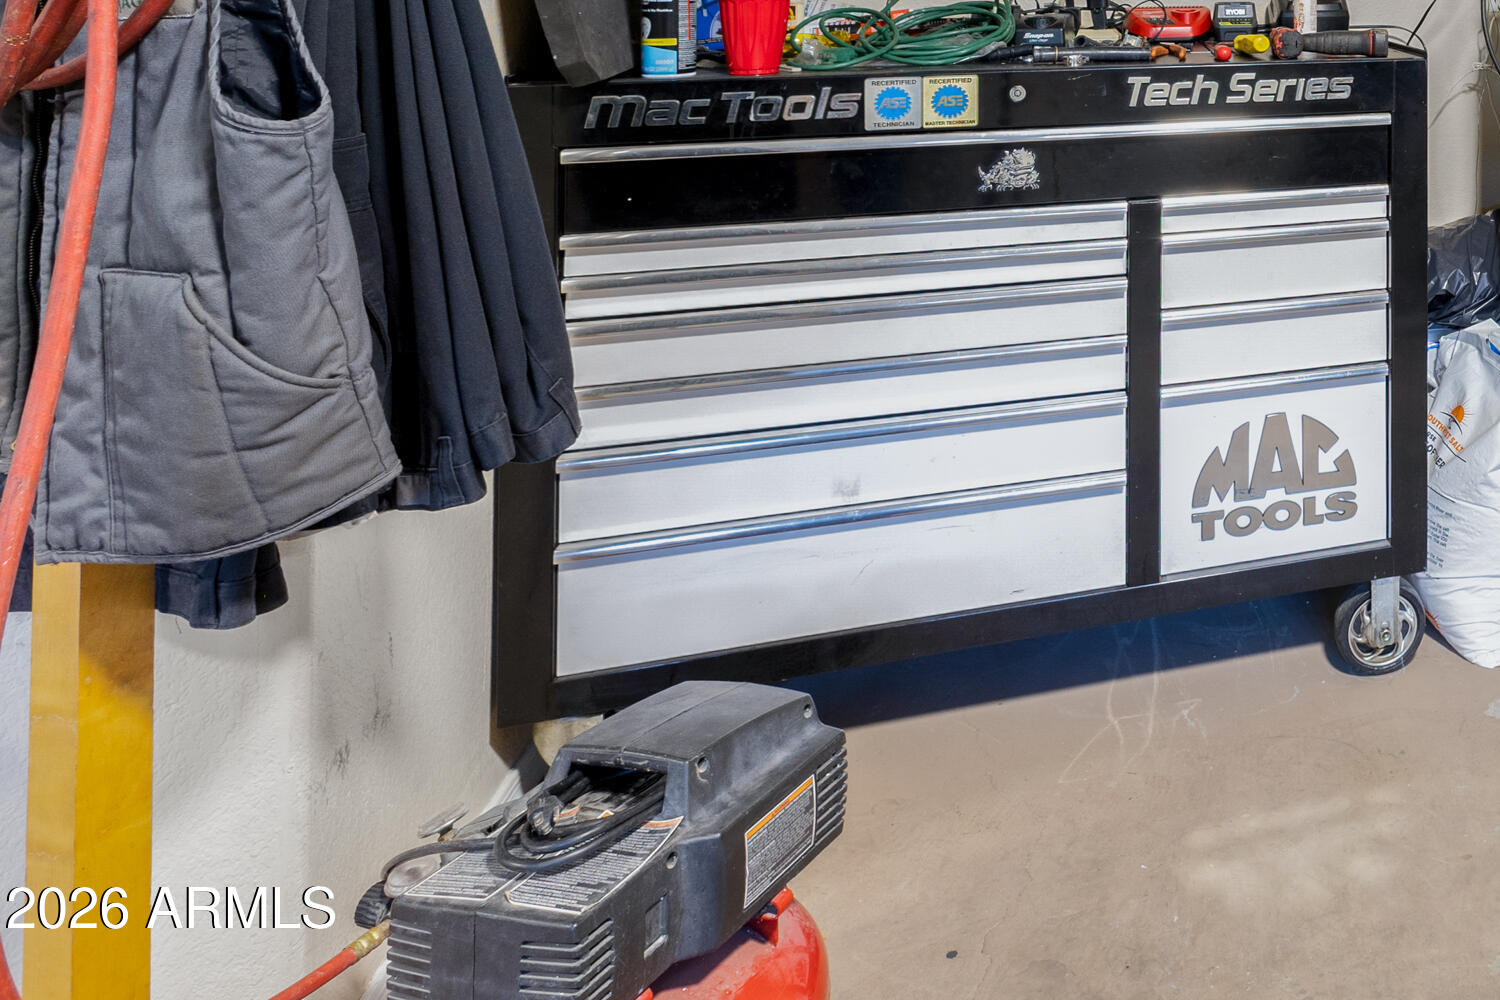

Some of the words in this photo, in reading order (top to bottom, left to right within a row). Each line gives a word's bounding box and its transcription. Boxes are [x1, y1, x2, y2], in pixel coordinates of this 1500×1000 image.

[1225, 8, 1246, 16] RYOBI
[929, 77, 973, 85] RECERTIFIED
[1127, 74, 1219, 107] Tech
[1225, 72, 1354, 103] Series
[720, 86, 863, 124] Tools
[879, 96, 907, 110] ASE
[936, 94, 963, 108] ASE
[1449, 435, 1465, 453] SALT
[1191, 411, 1358, 509] MAC
[1191, 490, 1358, 542] TOOLS
